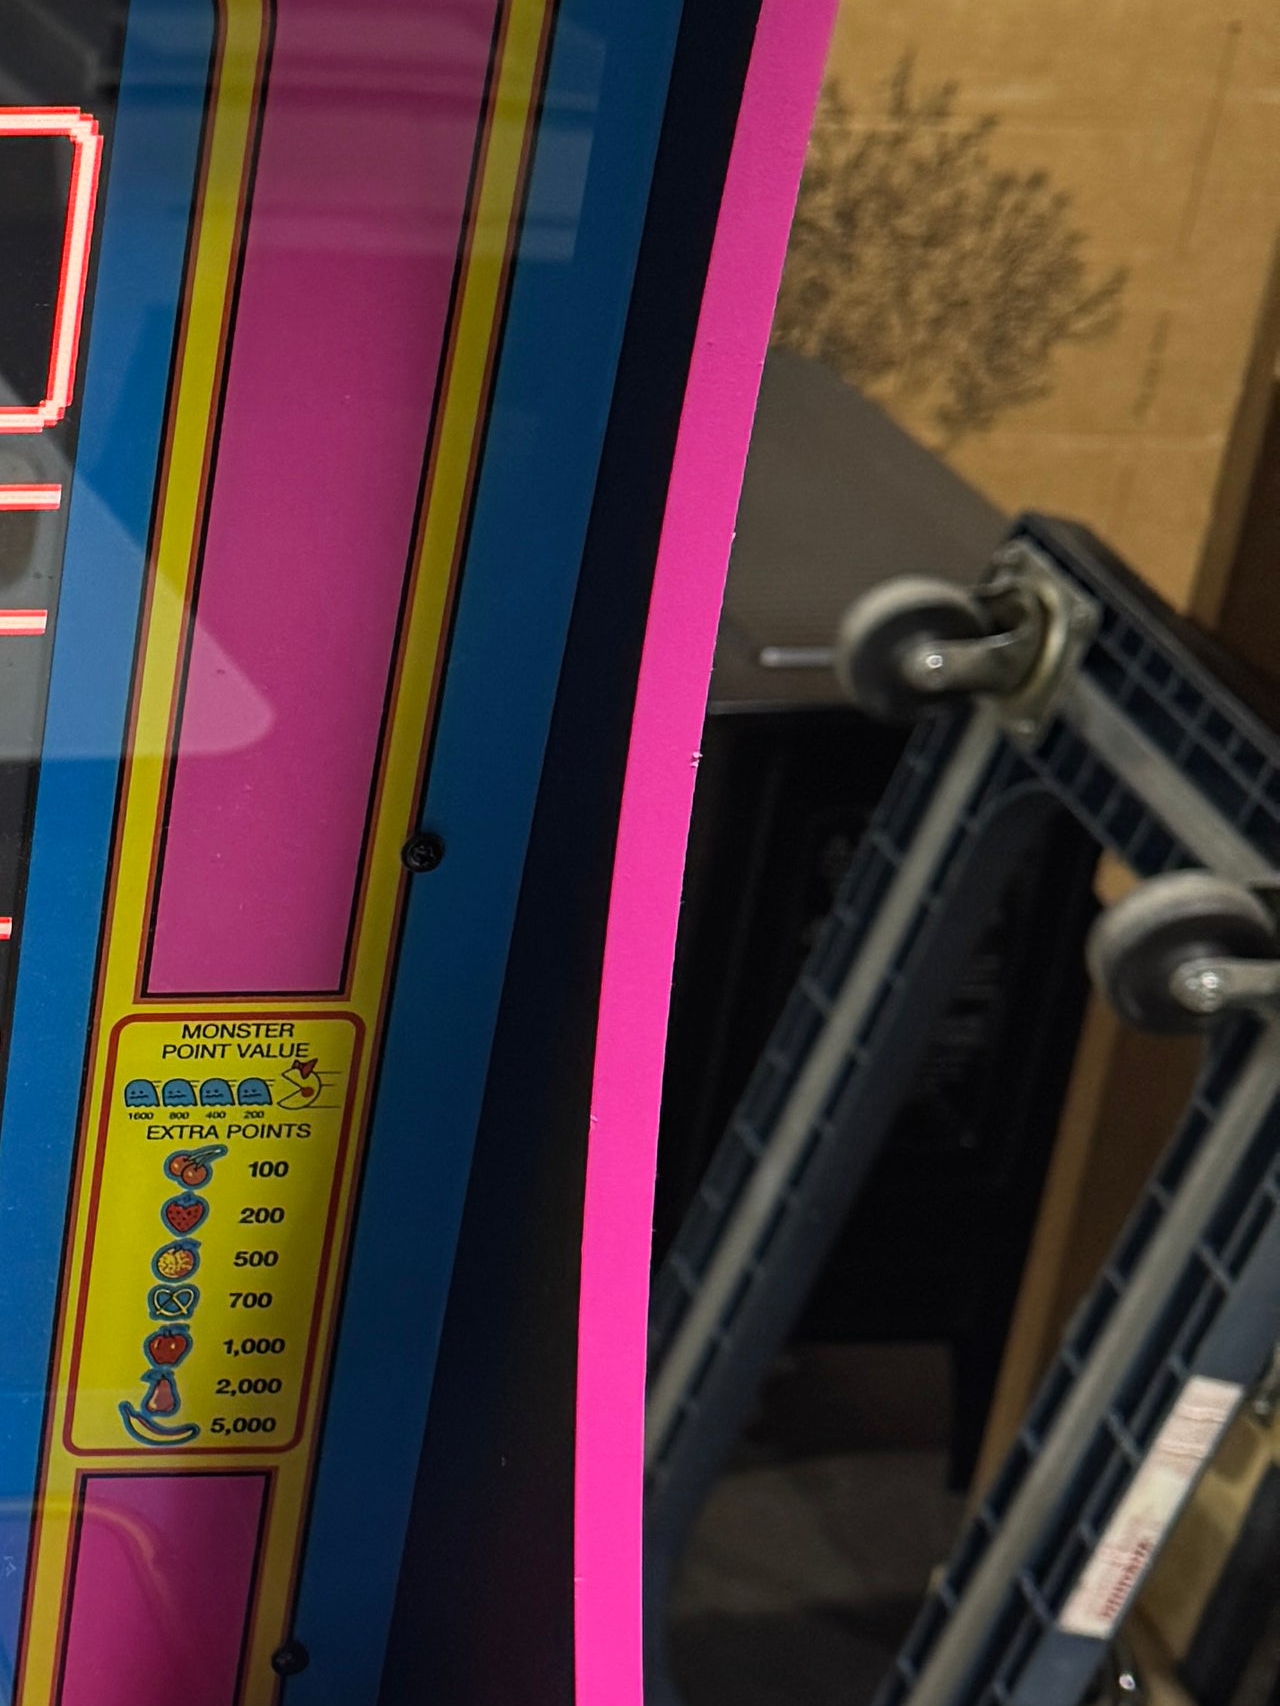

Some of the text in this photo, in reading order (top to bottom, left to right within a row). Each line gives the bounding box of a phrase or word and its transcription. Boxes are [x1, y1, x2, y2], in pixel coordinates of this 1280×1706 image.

[181, 1023, 295, 1039] MONSTER
[162, 1043, 310, 1059] POINT VALUE
[146, 1123, 312, 1140] EXTRA POINTS
[248, 1161, 289, 1178] 100
[239, 1208, 285, 1224] 200
[233, 1251, 279, 1267] 500
[229, 1292, 272, 1308] 700
[223, 1338, 286, 1357] 1,000
[215, 1378, 282, 1397] 2,000
[210, 1417, 276, 1436] 5,000
